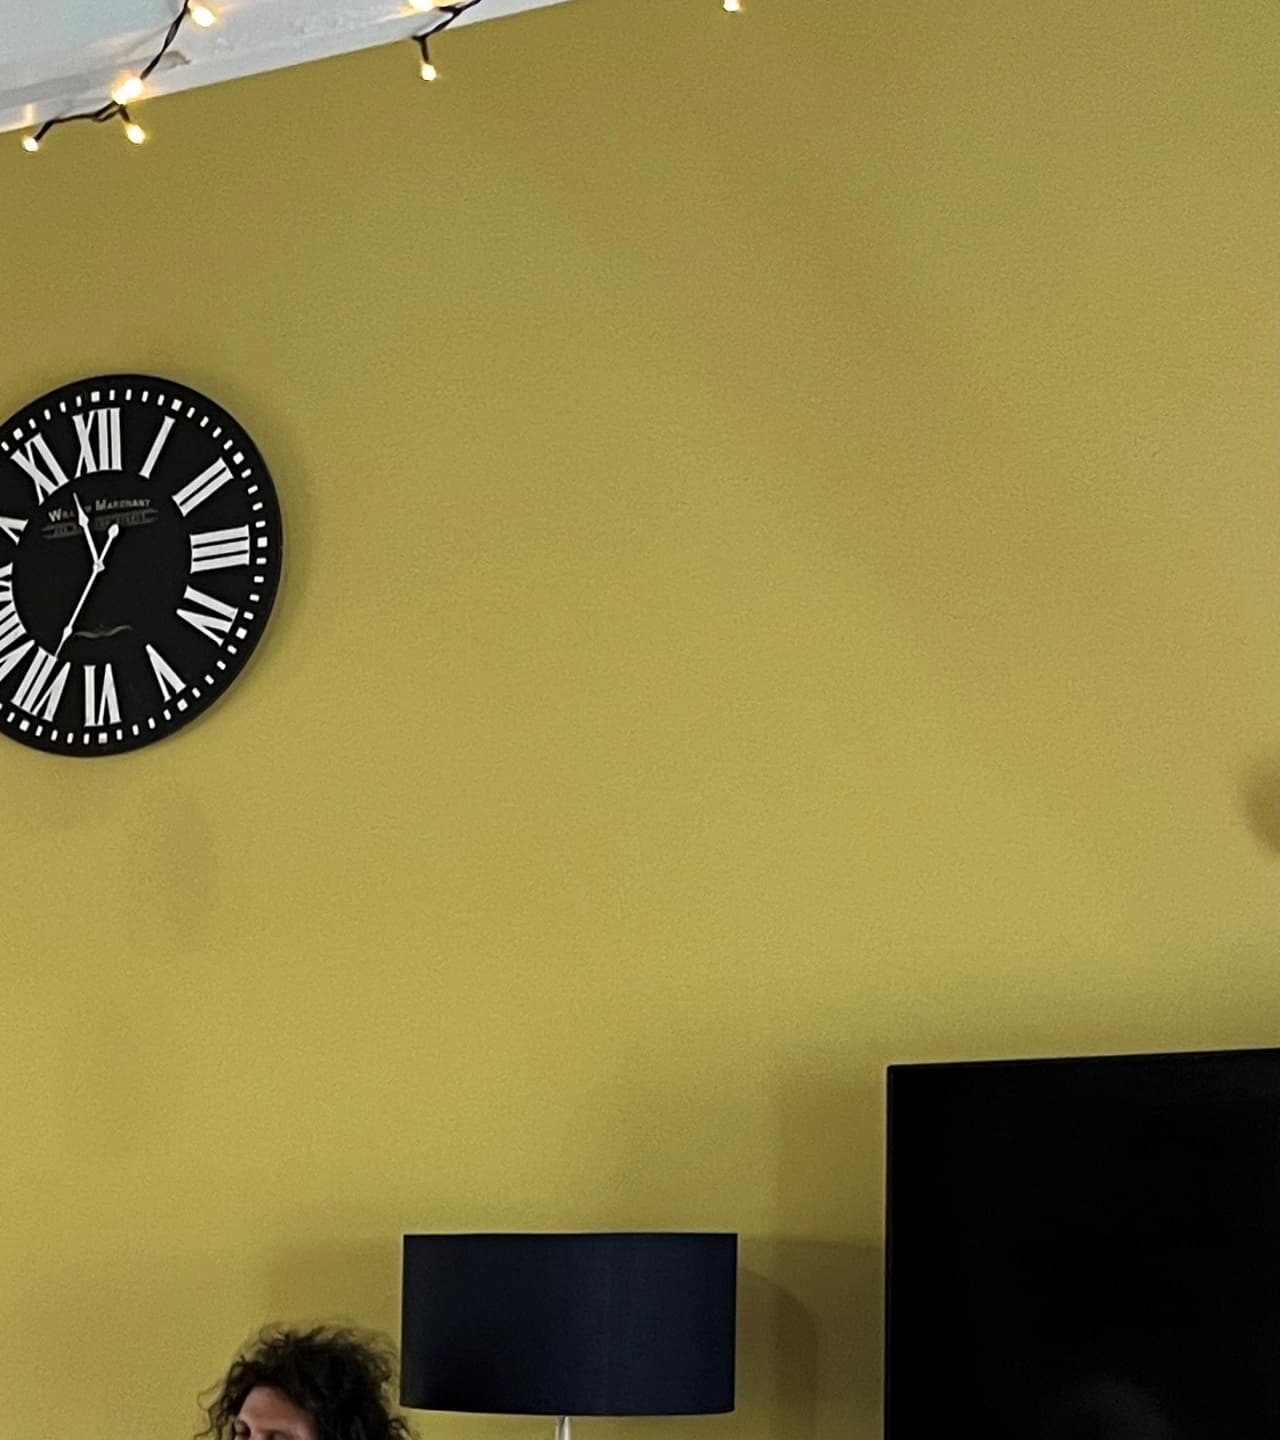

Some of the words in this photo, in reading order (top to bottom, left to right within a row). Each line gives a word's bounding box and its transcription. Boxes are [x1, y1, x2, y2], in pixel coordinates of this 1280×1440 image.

[10, 432, 70, 505] XI
[72, 407, 122, 479] XII
[171, 457, 235, 517] II
[189, 524, 251, 573] III
[10, 646, 71, 723] VII
[83, 663, 122, 728] VI
[144, 643, 187, 703] V
